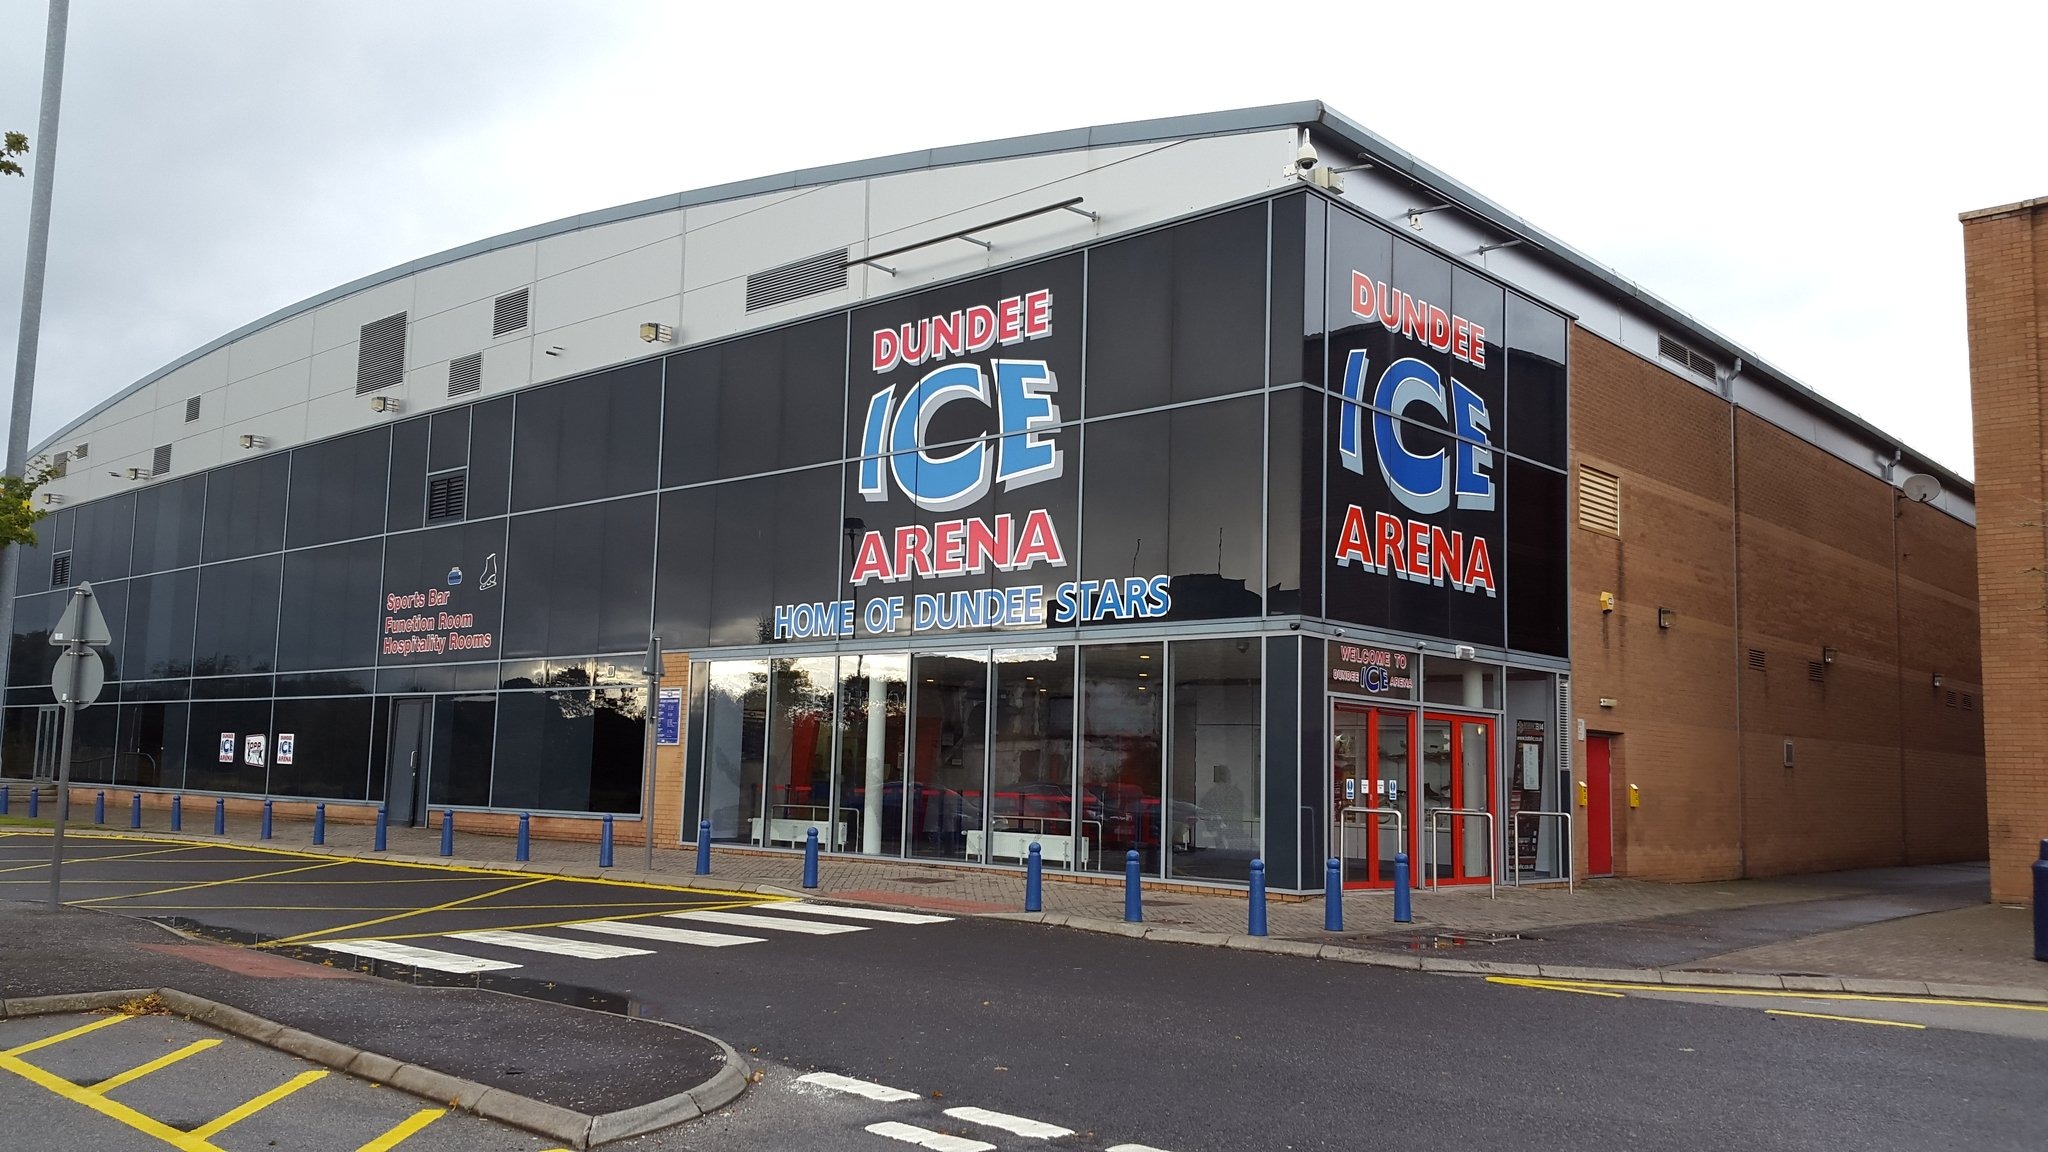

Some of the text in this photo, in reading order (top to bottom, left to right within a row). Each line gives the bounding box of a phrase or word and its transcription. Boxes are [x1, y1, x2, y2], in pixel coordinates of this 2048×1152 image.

[873, 288, 1053, 374] DUNDEE
[1350, 268, 1487, 371] DUNDEE
[858, 358, 1064, 512] ICE
[1339, 347, 1496, 514] ICE
[850, 508, 1067, 586] ARENA
[1334, 502, 1497, 599] ARENA
[384, 611, 474, 634] Function Room
[386, 588, 451, 613] Sports Bar
[774, 574, 1172, 640] HOME OF DUNDEE STARS
[383, 631, 492, 657] Hospitality Rooms
[1340, 645, 1407, 669] WELCOME TO
[1332, 665, 1413, 693] DUNDEE ICE ARENA
[221, 739, 233, 753] ICE
[279, 741, 292, 755] ICE
